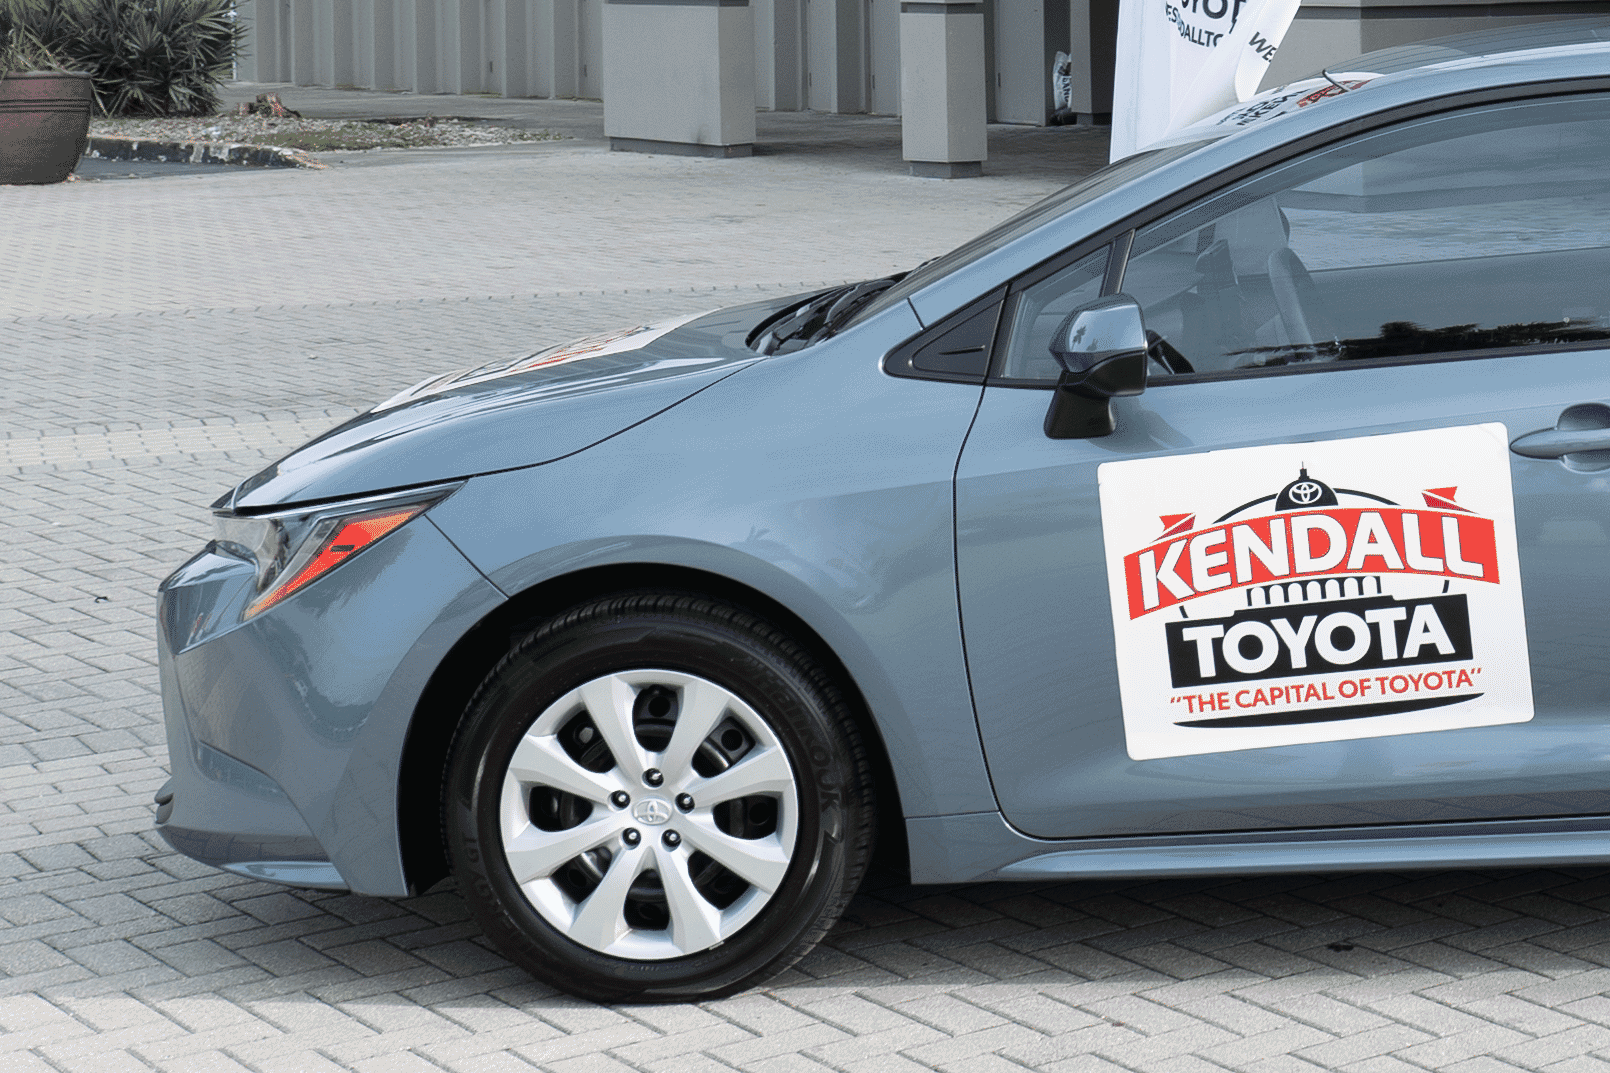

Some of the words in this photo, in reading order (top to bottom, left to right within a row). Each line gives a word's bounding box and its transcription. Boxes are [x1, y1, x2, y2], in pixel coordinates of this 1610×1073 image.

[1138, 510, 1485, 612] KENDALL
[1181, 602, 1456, 680] TOYOTA
[1234, 681, 1335, 709] CAPITAL
[1338, 678, 1372, 699] OF
